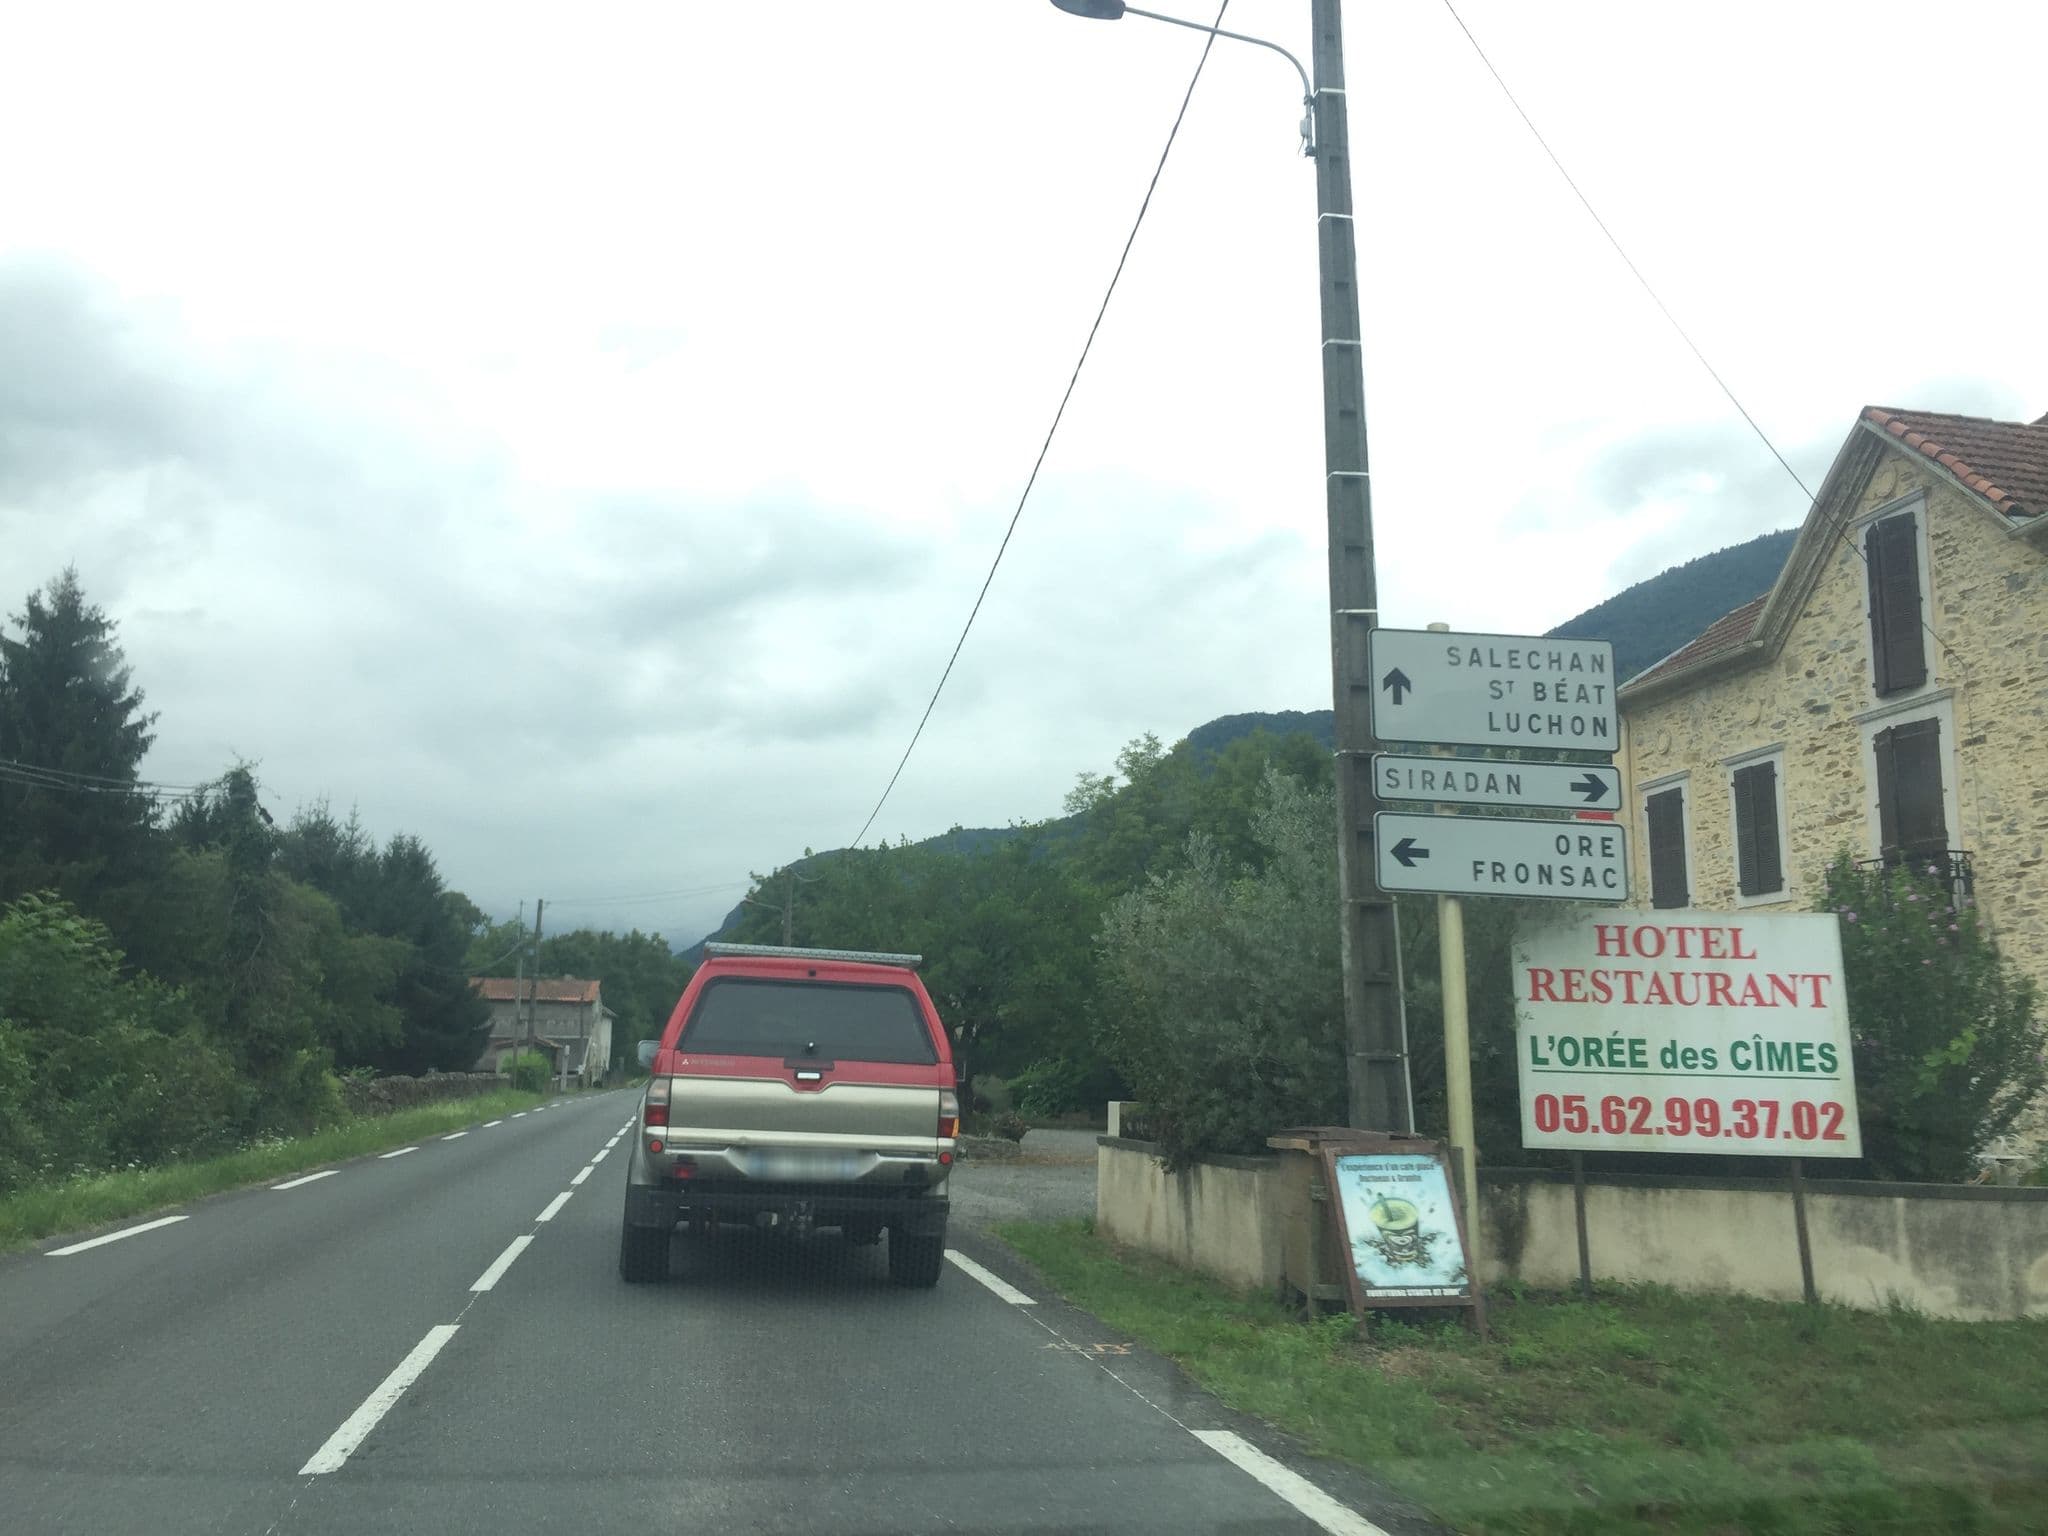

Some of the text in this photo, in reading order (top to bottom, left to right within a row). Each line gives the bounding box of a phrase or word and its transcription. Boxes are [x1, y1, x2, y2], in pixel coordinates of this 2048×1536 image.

[1446, 646, 1605, 672] SALECHAN
[1533, 677, 1606, 705] BÉAT
[1488, 711, 1608, 738] LUCHON
[1385, 768, 1521, 795] SIRADAN
[1555, 834, 1616, 858] ORE
[1472, 860, 1618, 889] FRONSAC
[1593, 924, 1757, 960] HOTEL
[1527, 967, 1832, 1009] RESTAURANT
[1530, 1030, 1839, 1074] L'ORÉE des CÎMES
[1534, 1093, 1848, 1141] 05.62.99.37.02
